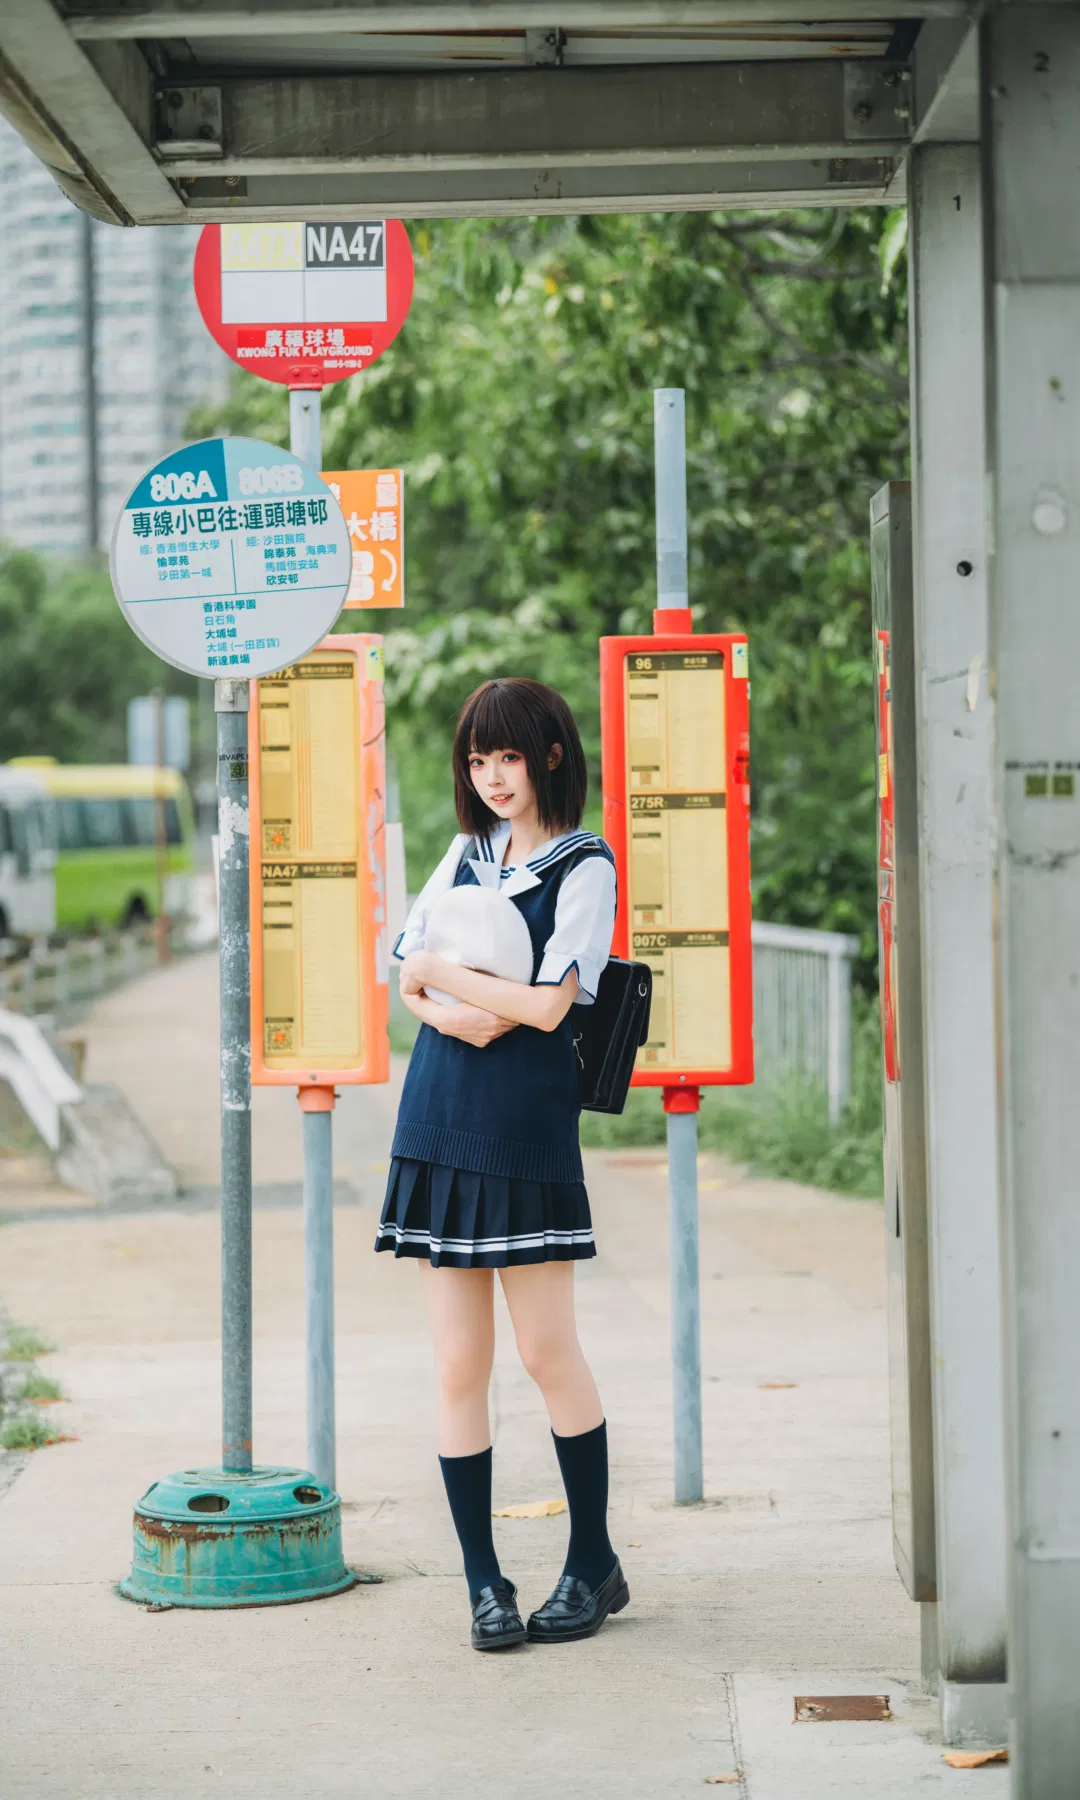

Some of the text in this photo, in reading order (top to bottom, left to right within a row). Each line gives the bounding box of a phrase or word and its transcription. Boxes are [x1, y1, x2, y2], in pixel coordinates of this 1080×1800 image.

[225, 227, 300, 263] A47X
[306, 226, 382, 262] NA47
[237, 345, 373, 358] KWONG FUK PLAYGROUND
[238, 464, 304, 495] 806B
[150, 471, 217, 502] 806A
[266, 573, 299, 586] 欣安邨
[203, 599, 256, 613] 香港科學園
[204, 614, 236, 626] 白石角
[635, 657, 652, 670] 96
[631, 796, 665, 809] 275R
[262, 865, 298, 878] NA47
[634, 934, 667, 947] 907C
